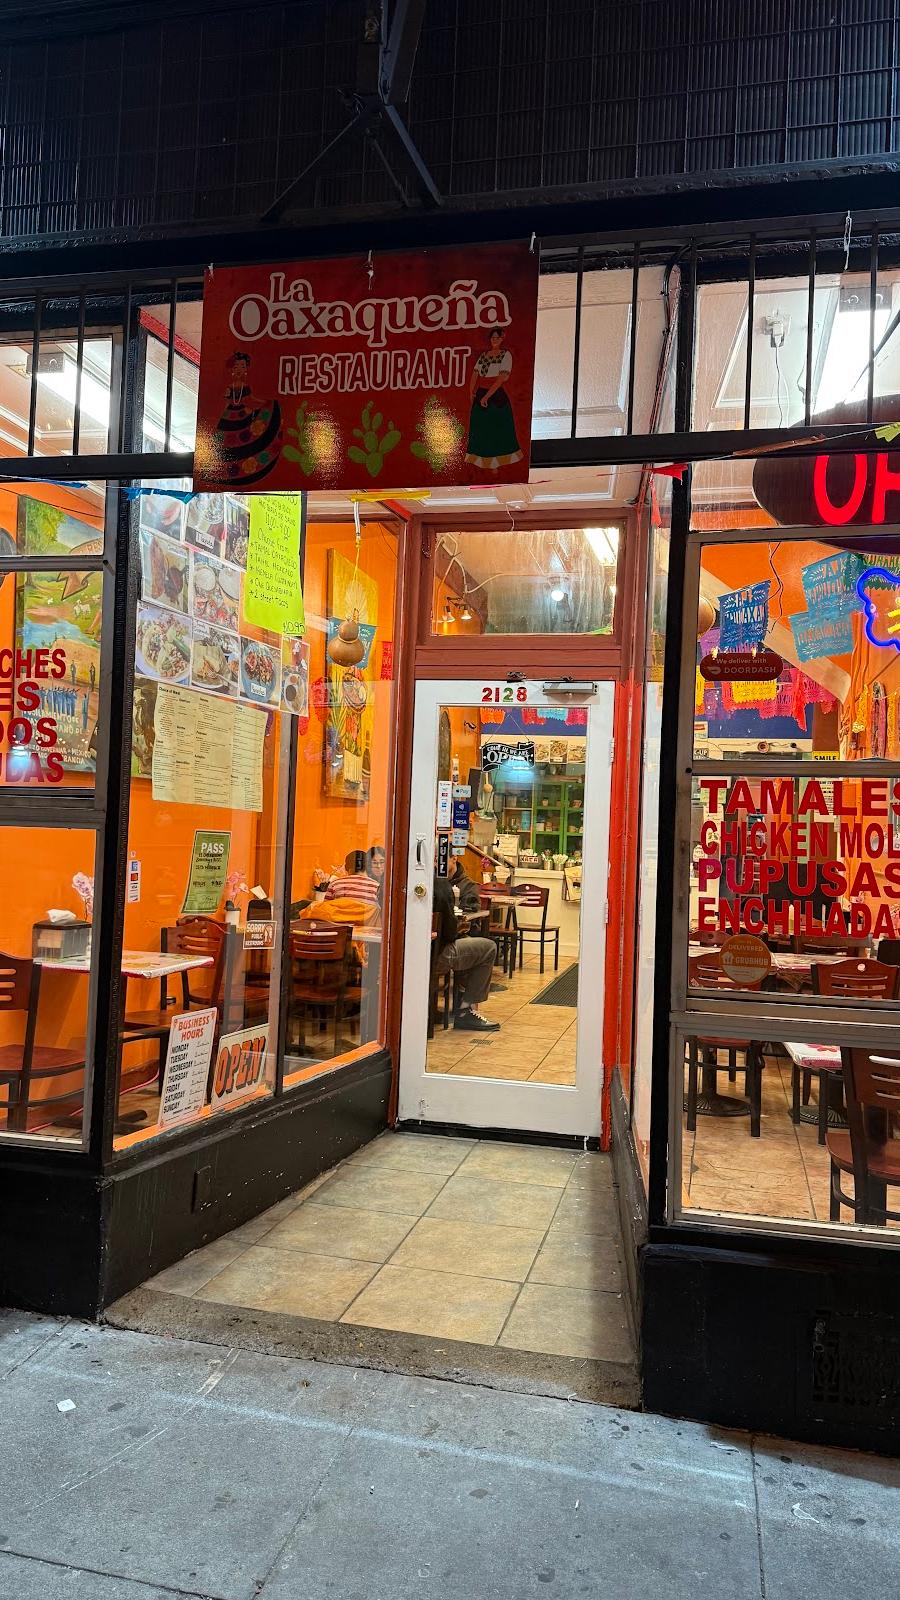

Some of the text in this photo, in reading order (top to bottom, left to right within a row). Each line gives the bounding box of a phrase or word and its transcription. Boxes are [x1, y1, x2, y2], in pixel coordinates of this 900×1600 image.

[270, 272, 314, 303] La
[229, 280, 512, 348] Oaxaqueña
[278, 346, 471, 395] RESTAURANT
[482, 687, 528, 702] 2128
[700, 820, 828, 857] CHICKEN
[201, 842, 225, 854] PASS
[440, 837, 448, 874] PULL
[698, 897, 900, 939] ENCHILADA
[247, 923, 265, 933] SORRY
[736, 957, 768, 966] GRUBHUB
[178, 1016, 210, 1030] BUSINESS
[181, 1028, 204, 1041] HOURS
[172, 1043, 189, 1054] MONDAY
[170, 1053, 188, 1063] TUESDAY
[169, 1060, 193, 1074] WEDNESDAY
[216, 1036, 266, 1098] OPEN
[168, 1072, 188, 1083] THURSDAY
[166, 1083, 180, 1094] FRIDAY
[164, 1091, 185, 1103] SATURDAY
[163, 1101, 180, 1114] SUNDAY
